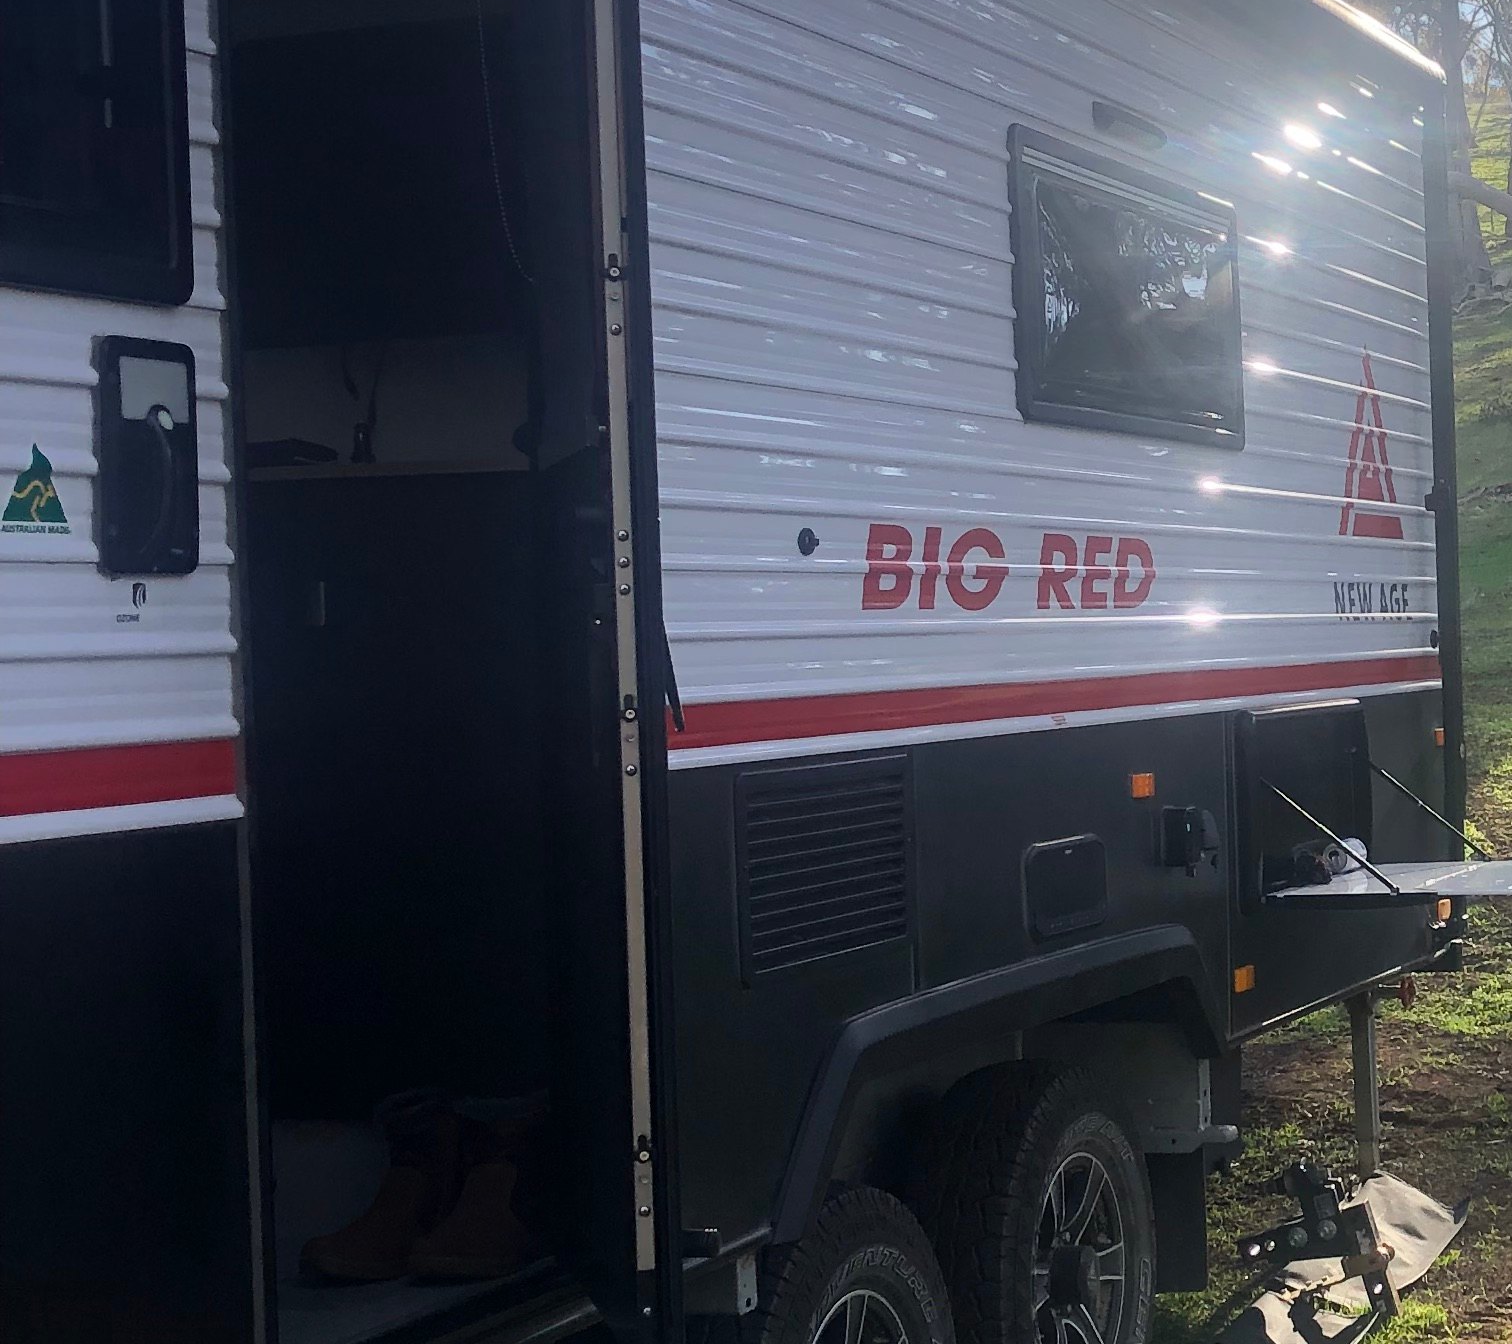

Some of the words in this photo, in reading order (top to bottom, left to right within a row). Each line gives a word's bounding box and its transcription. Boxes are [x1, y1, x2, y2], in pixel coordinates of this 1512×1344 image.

[862, 524, 1009, 610] BIG
[1037, 534, 1156, 610] RED
[1334, 582, 1375, 620] NEW
[1380, 583, 1413, 620] AGE
[815, 1244, 936, 1323] VENTURE
